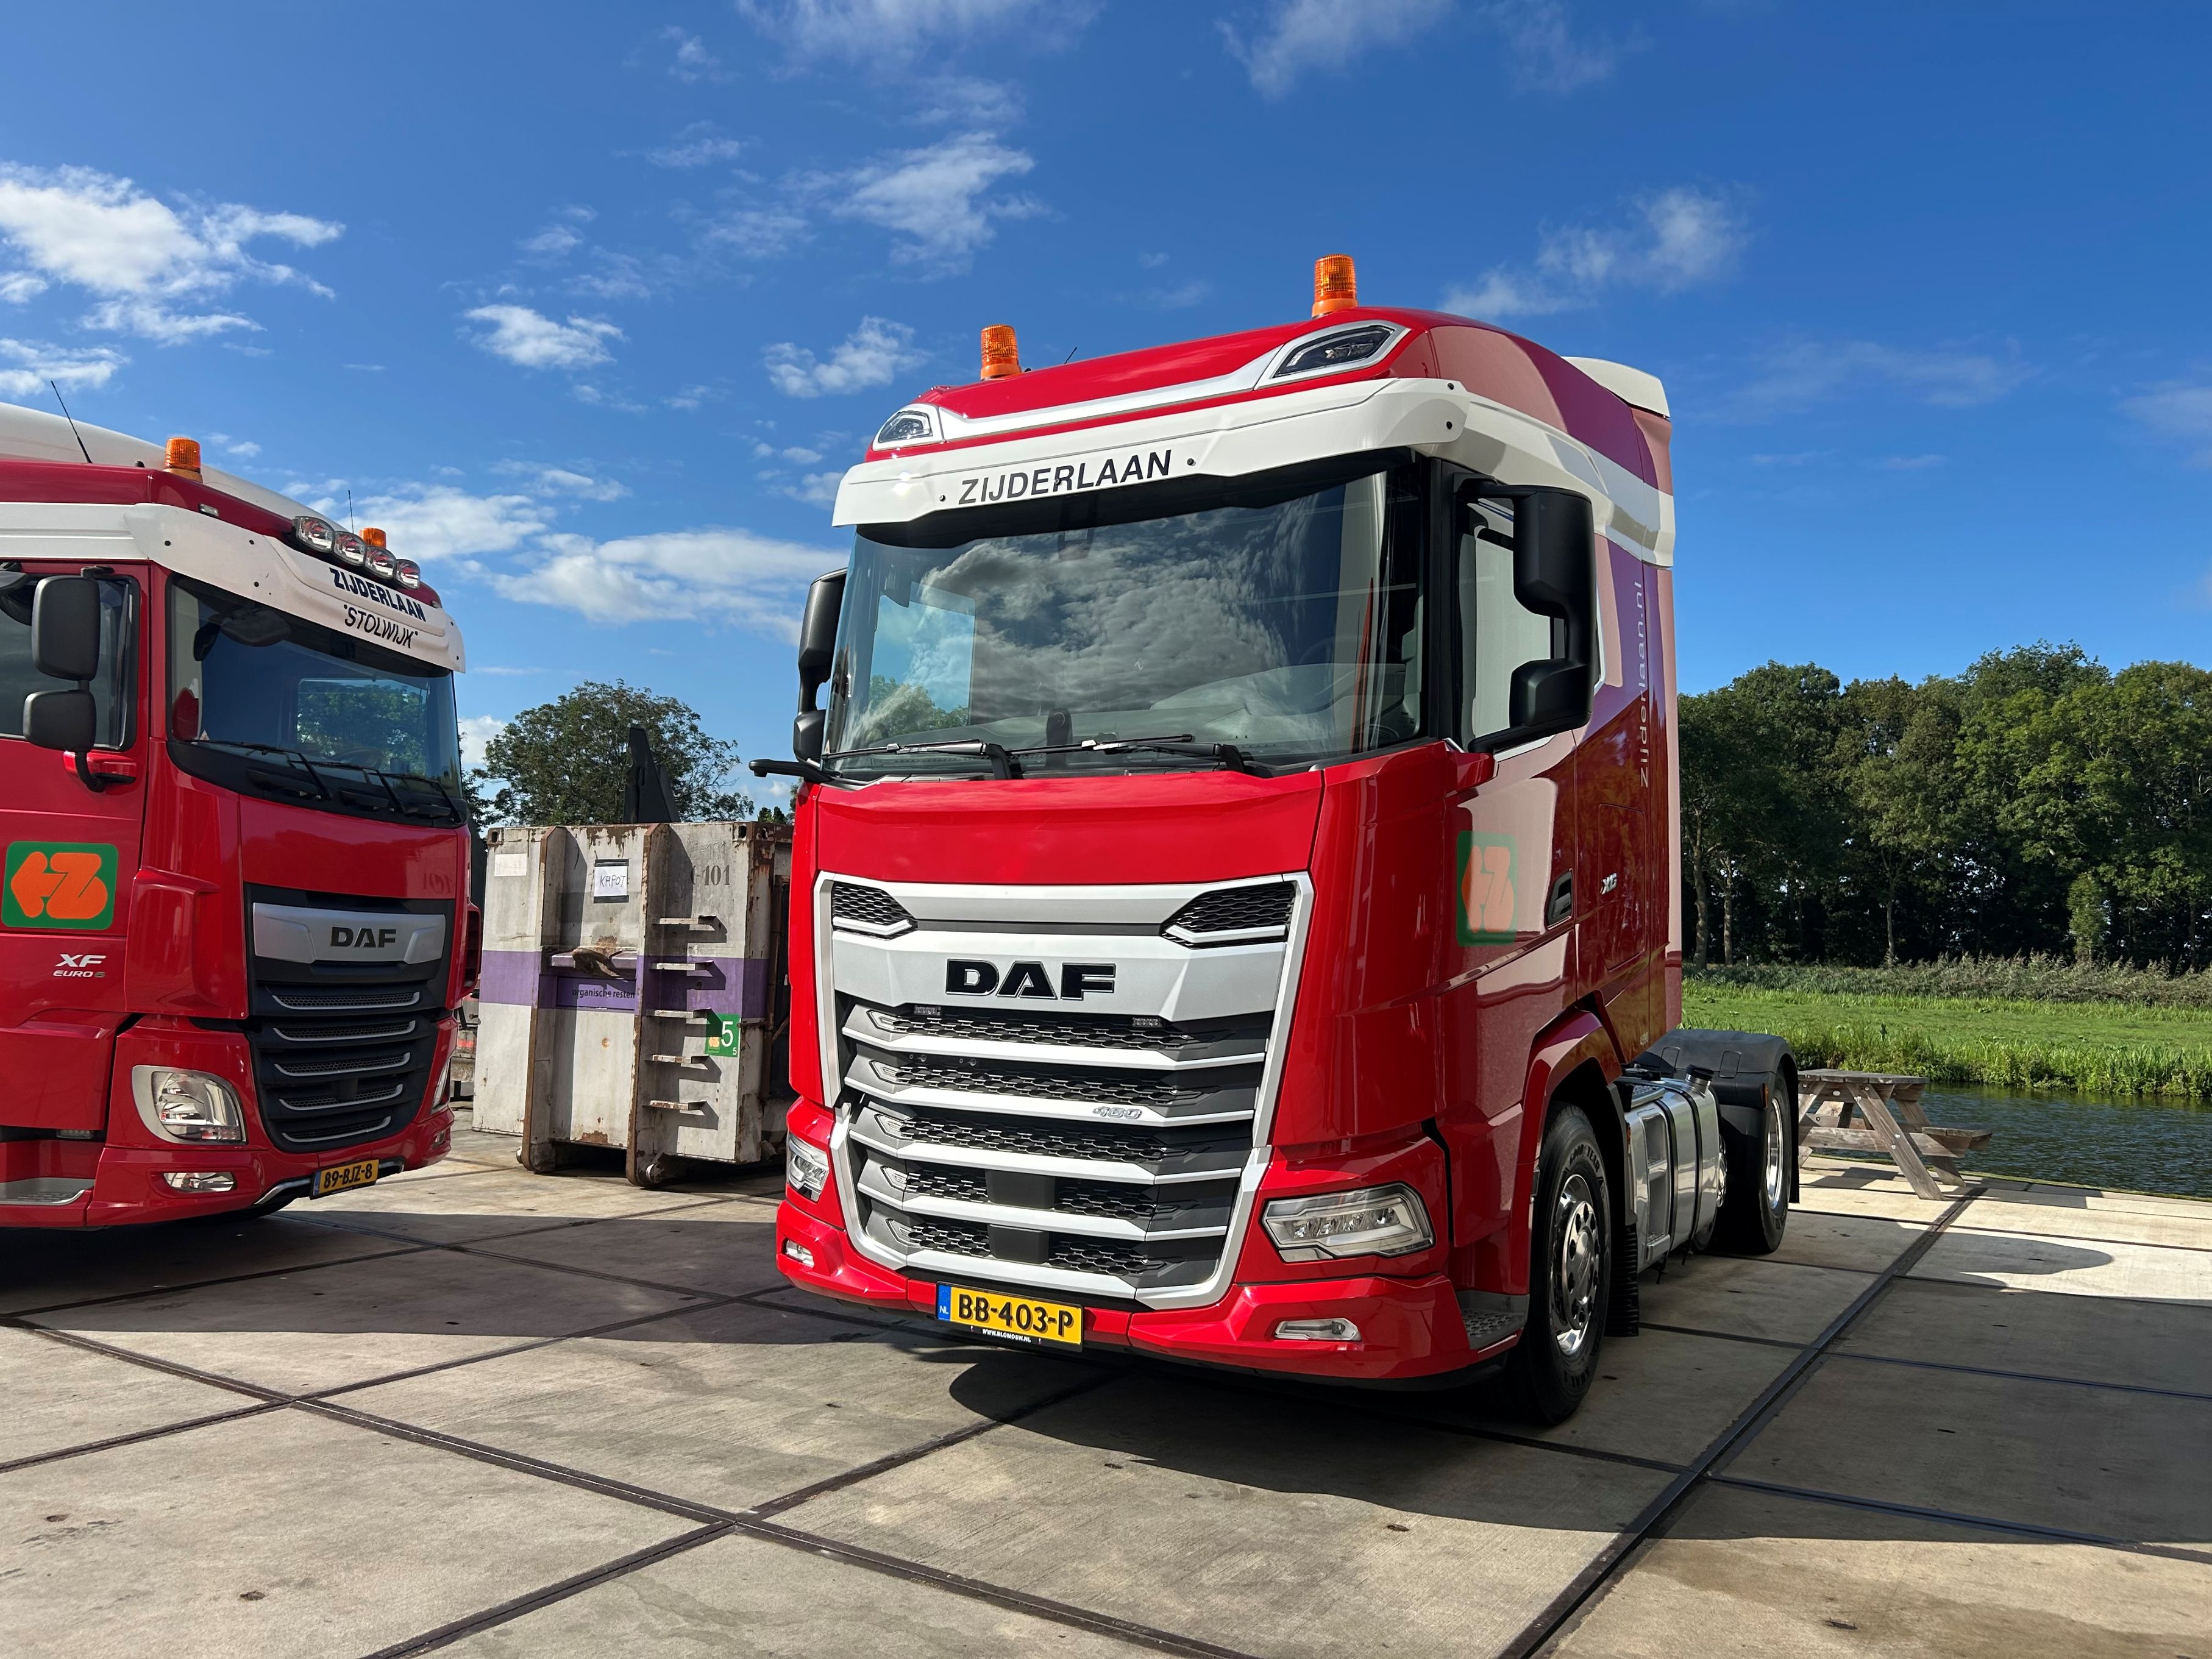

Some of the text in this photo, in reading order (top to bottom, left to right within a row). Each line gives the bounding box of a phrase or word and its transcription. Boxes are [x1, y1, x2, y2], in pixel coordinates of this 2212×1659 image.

[958, 450, 1172, 505] ZIJDERLAAN
[329, 567, 427, 622] ZIJDERLAAN
[600, 874, 627, 887] KAPOT
[330, 926, 397, 948] DAF
[55, 953, 107, 967] XF
[945, 958, 1116, 1001] DAF
[572, 988, 635, 999] organische resten
[720, 1020, 734, 1047] 5
[732, 1046, 738, 1056] 5
[324, 1163, 372, 1189] 89-BJZ-8
[939, 1305, 949, 1315] NL
[959, 1293, 1074, 1337] BB-403-P
